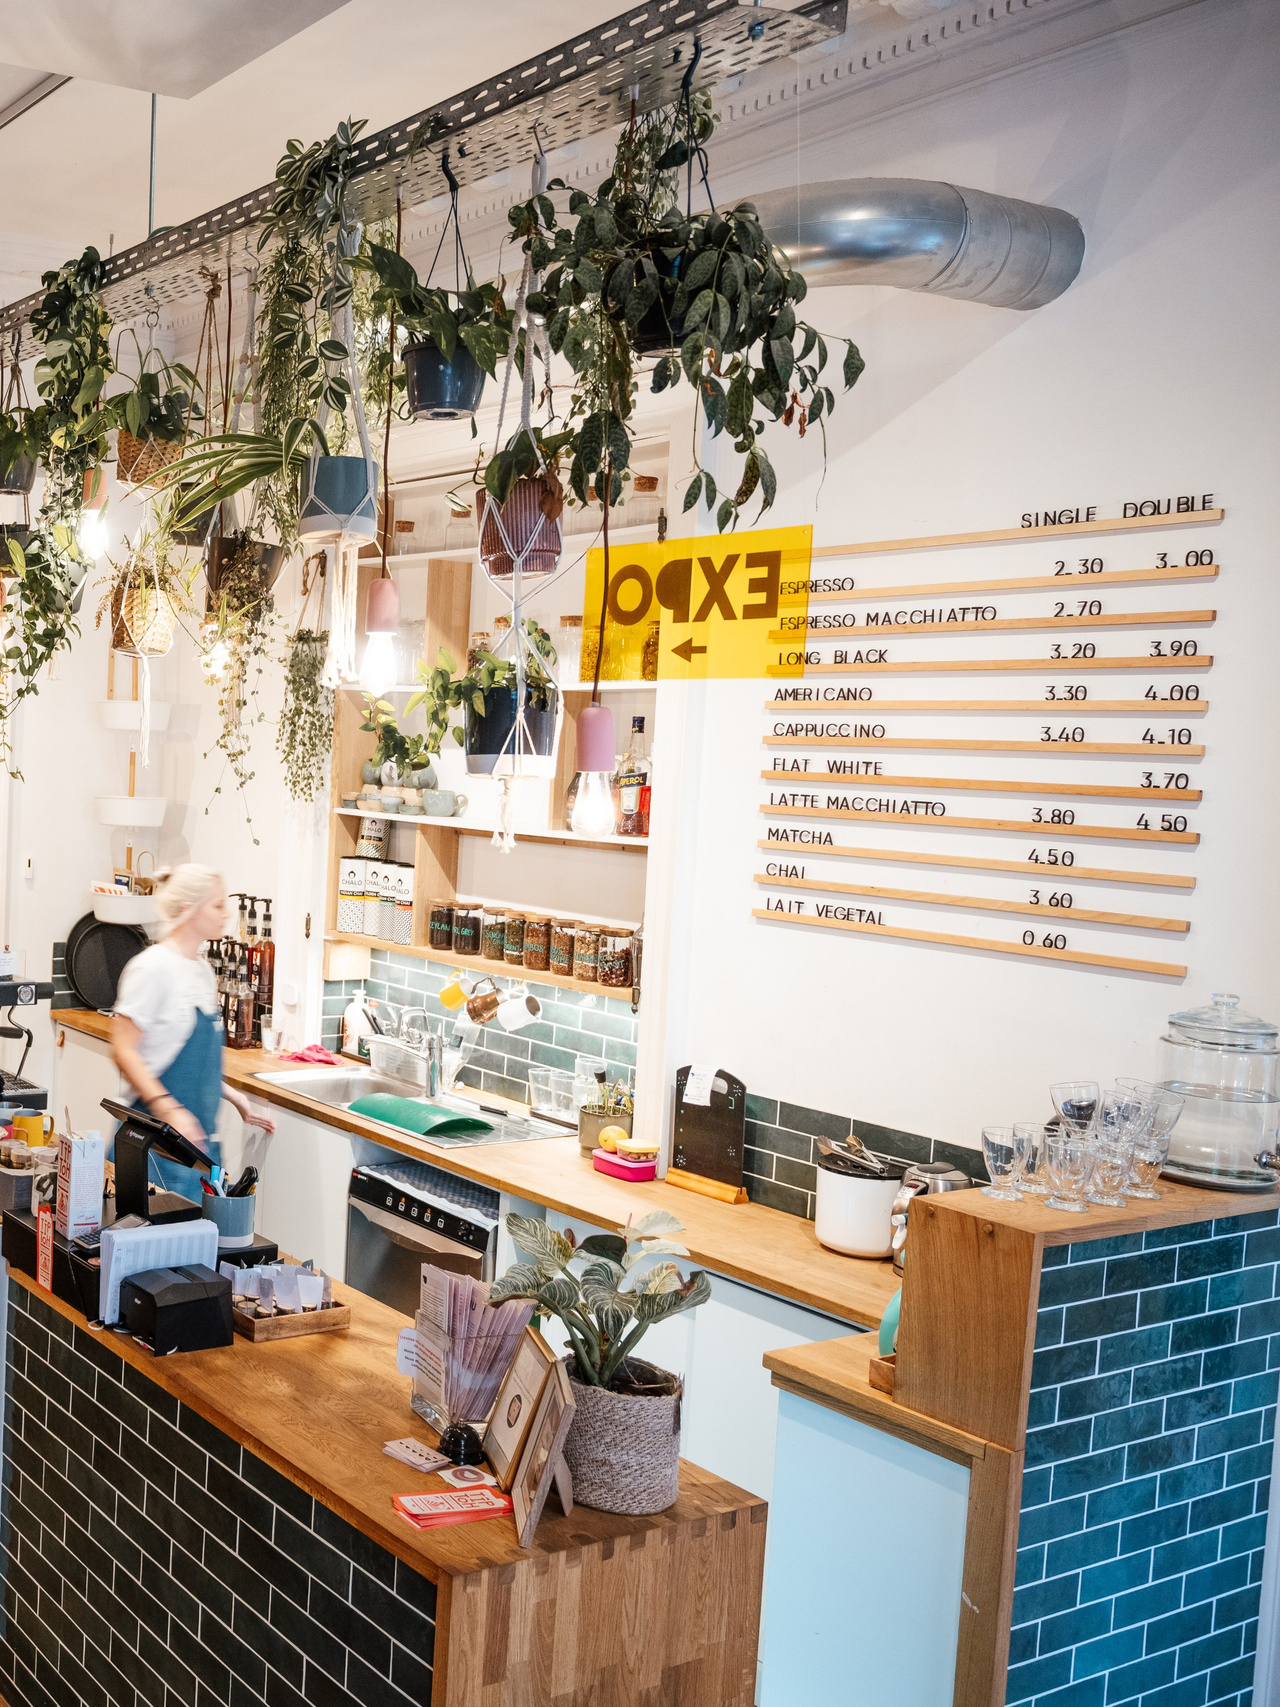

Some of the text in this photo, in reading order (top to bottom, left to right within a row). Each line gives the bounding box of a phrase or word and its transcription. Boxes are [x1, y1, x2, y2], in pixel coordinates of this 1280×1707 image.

[1020, 493, 1214, 529] SINGLE DOUBLE
[780, 577, 855, 595] ESPRESSO
[780, 613, 856, 630] ESPRESSO
[866, 606, 997, 626] MACCHIATTO
[778, 651, 821, 665] LONG
[833, 649, 888, 664] BLACK
[774, 687, 872, 701] AMERICANO
[773, 722, 885, 738] CAPPUCCINO
[773, 757, 811, 772] FLAT
[827, 759, 883, 775] WHITE
[770, 793, 819, 808] LATTE
[827, 796, 946, 817] MACCHIATTO
[767, 828, 834, 845] MATCHA
[766, 863, 805, 879] CHAI
[766, 898, 805, 915] LAIT
[816, 903, 886, 926] VEGETAL
